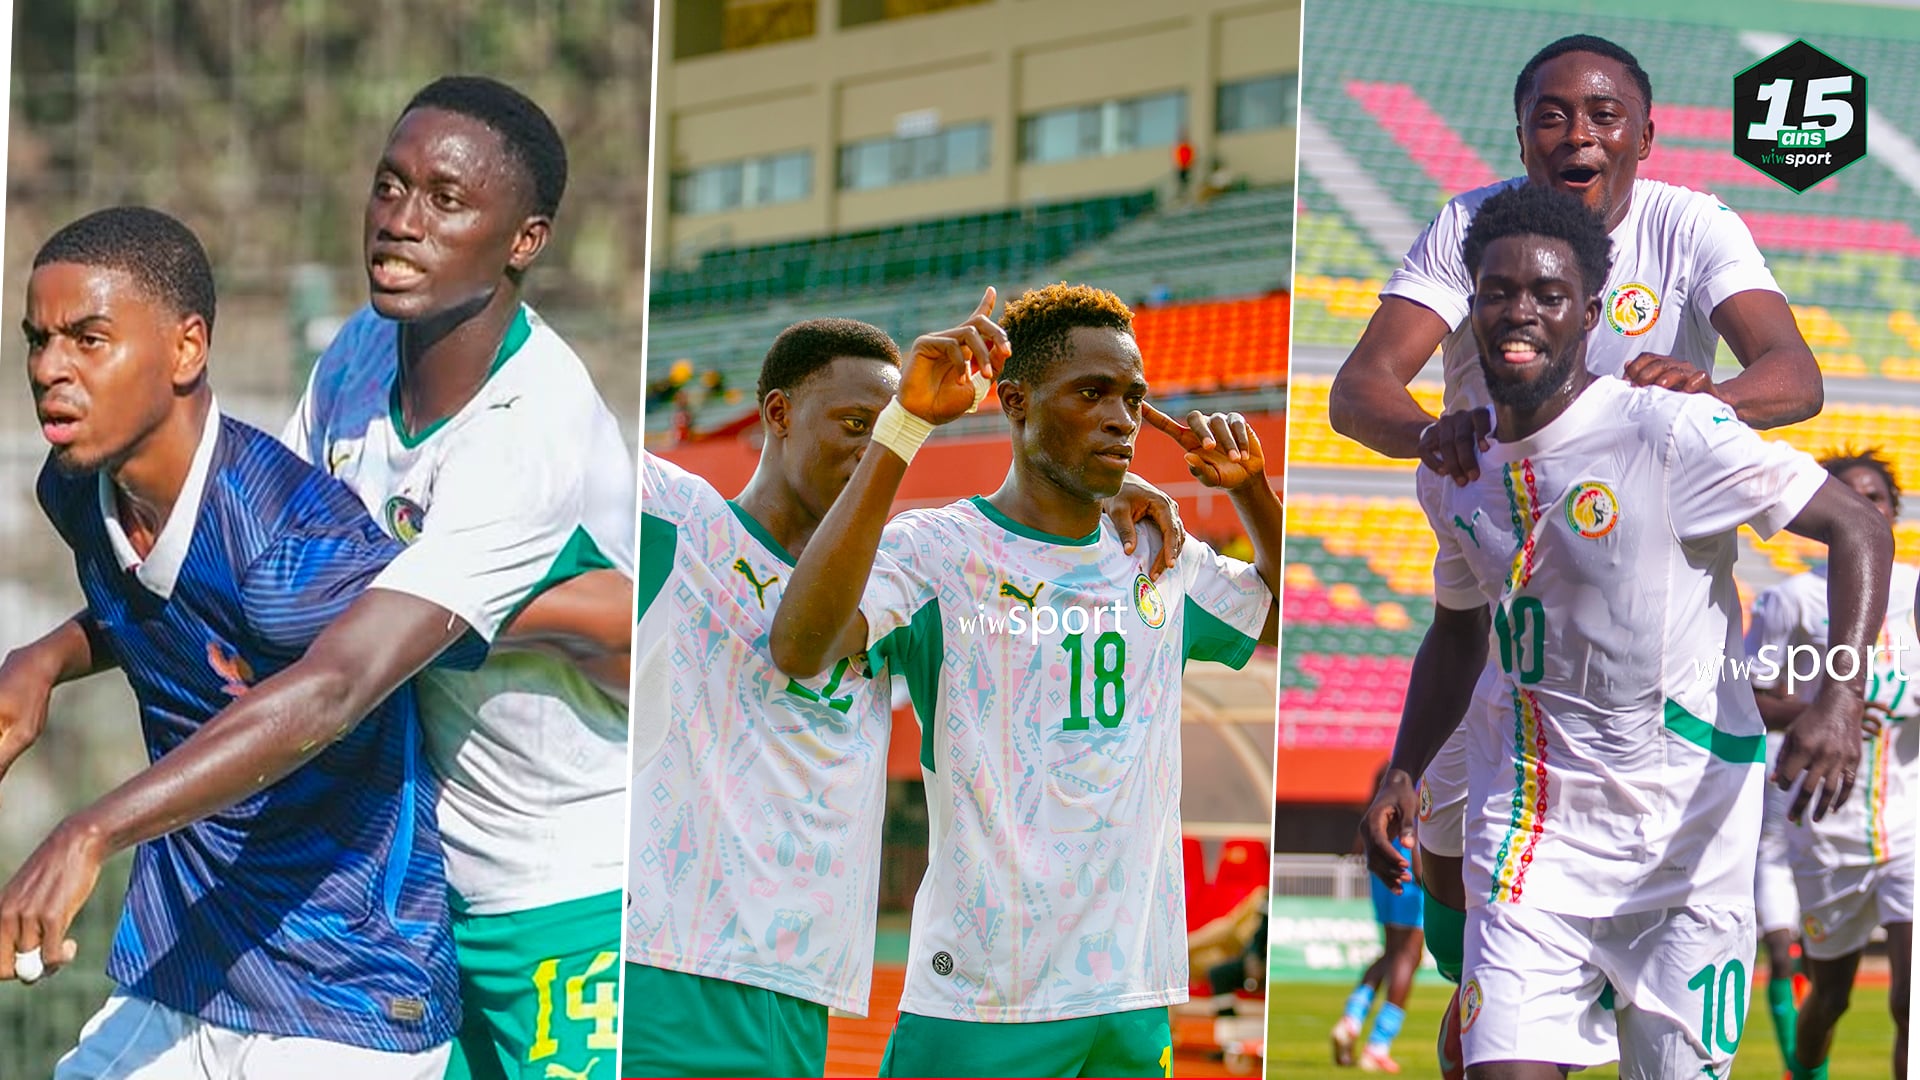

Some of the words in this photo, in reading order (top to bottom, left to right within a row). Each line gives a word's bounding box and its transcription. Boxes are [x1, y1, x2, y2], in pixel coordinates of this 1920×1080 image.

[1060, 631, 1126, 731] 18
[1494, 596, 1545, 685] 10
[529, 951, 619, 1062] 14
[1687, 959, 1746, 1055] 10
